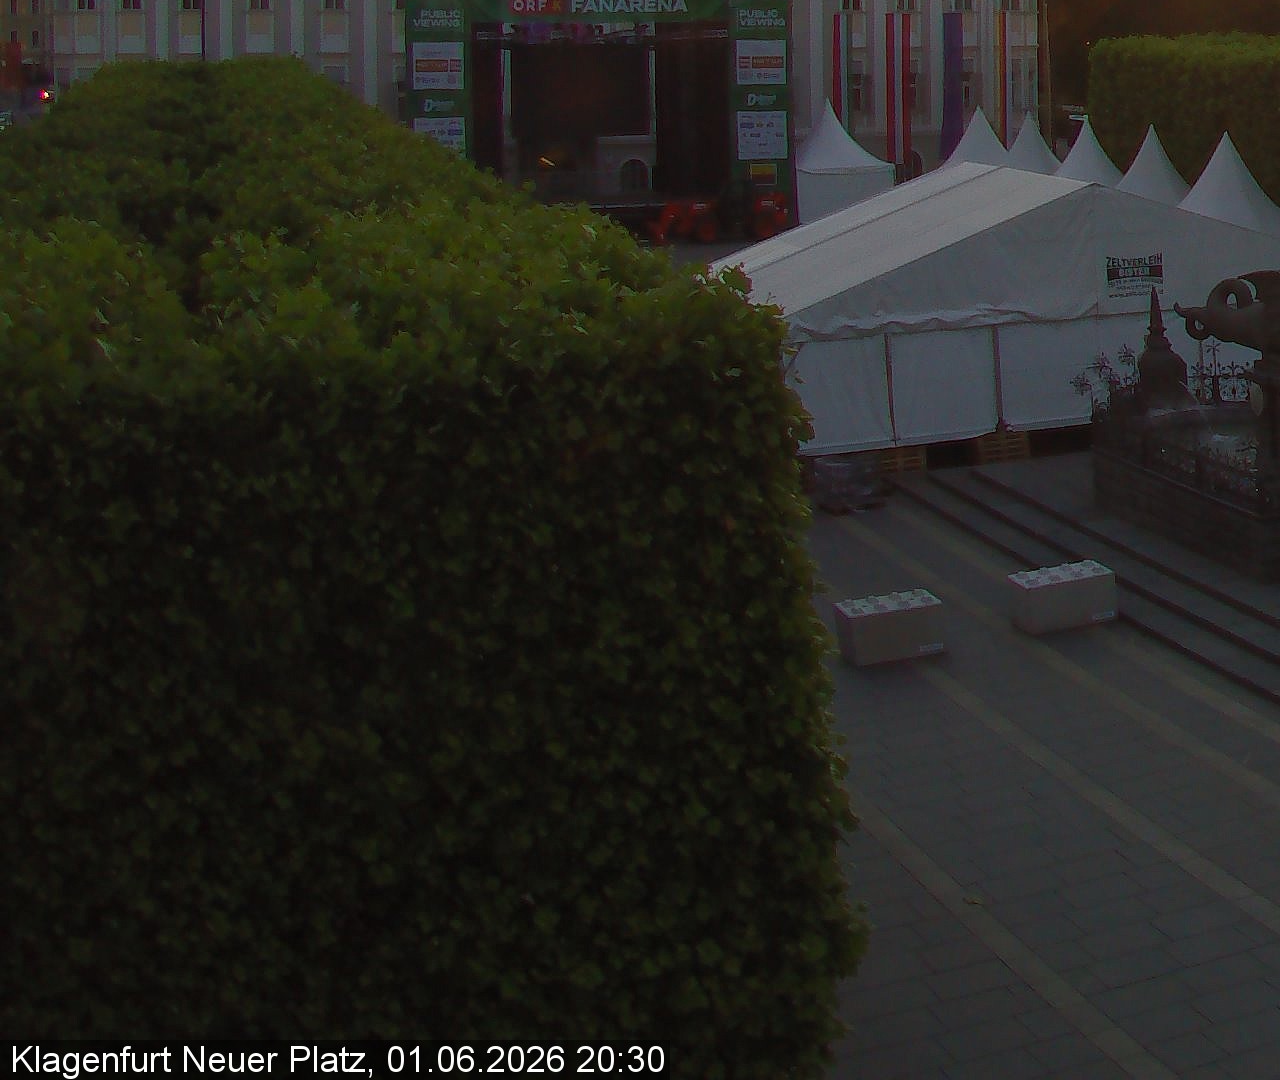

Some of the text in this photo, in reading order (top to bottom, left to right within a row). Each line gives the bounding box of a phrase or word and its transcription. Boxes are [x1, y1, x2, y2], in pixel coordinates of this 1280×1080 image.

[420, 8, 461, 18] PUBLIC
[739, 9, 778, 18] PUBLIC
[413, 18, 461, 28] VIEWING
[740, 18, 786, 27] VIEWING
[1106, 252, 1163, 268] ZELTVERLEIH
